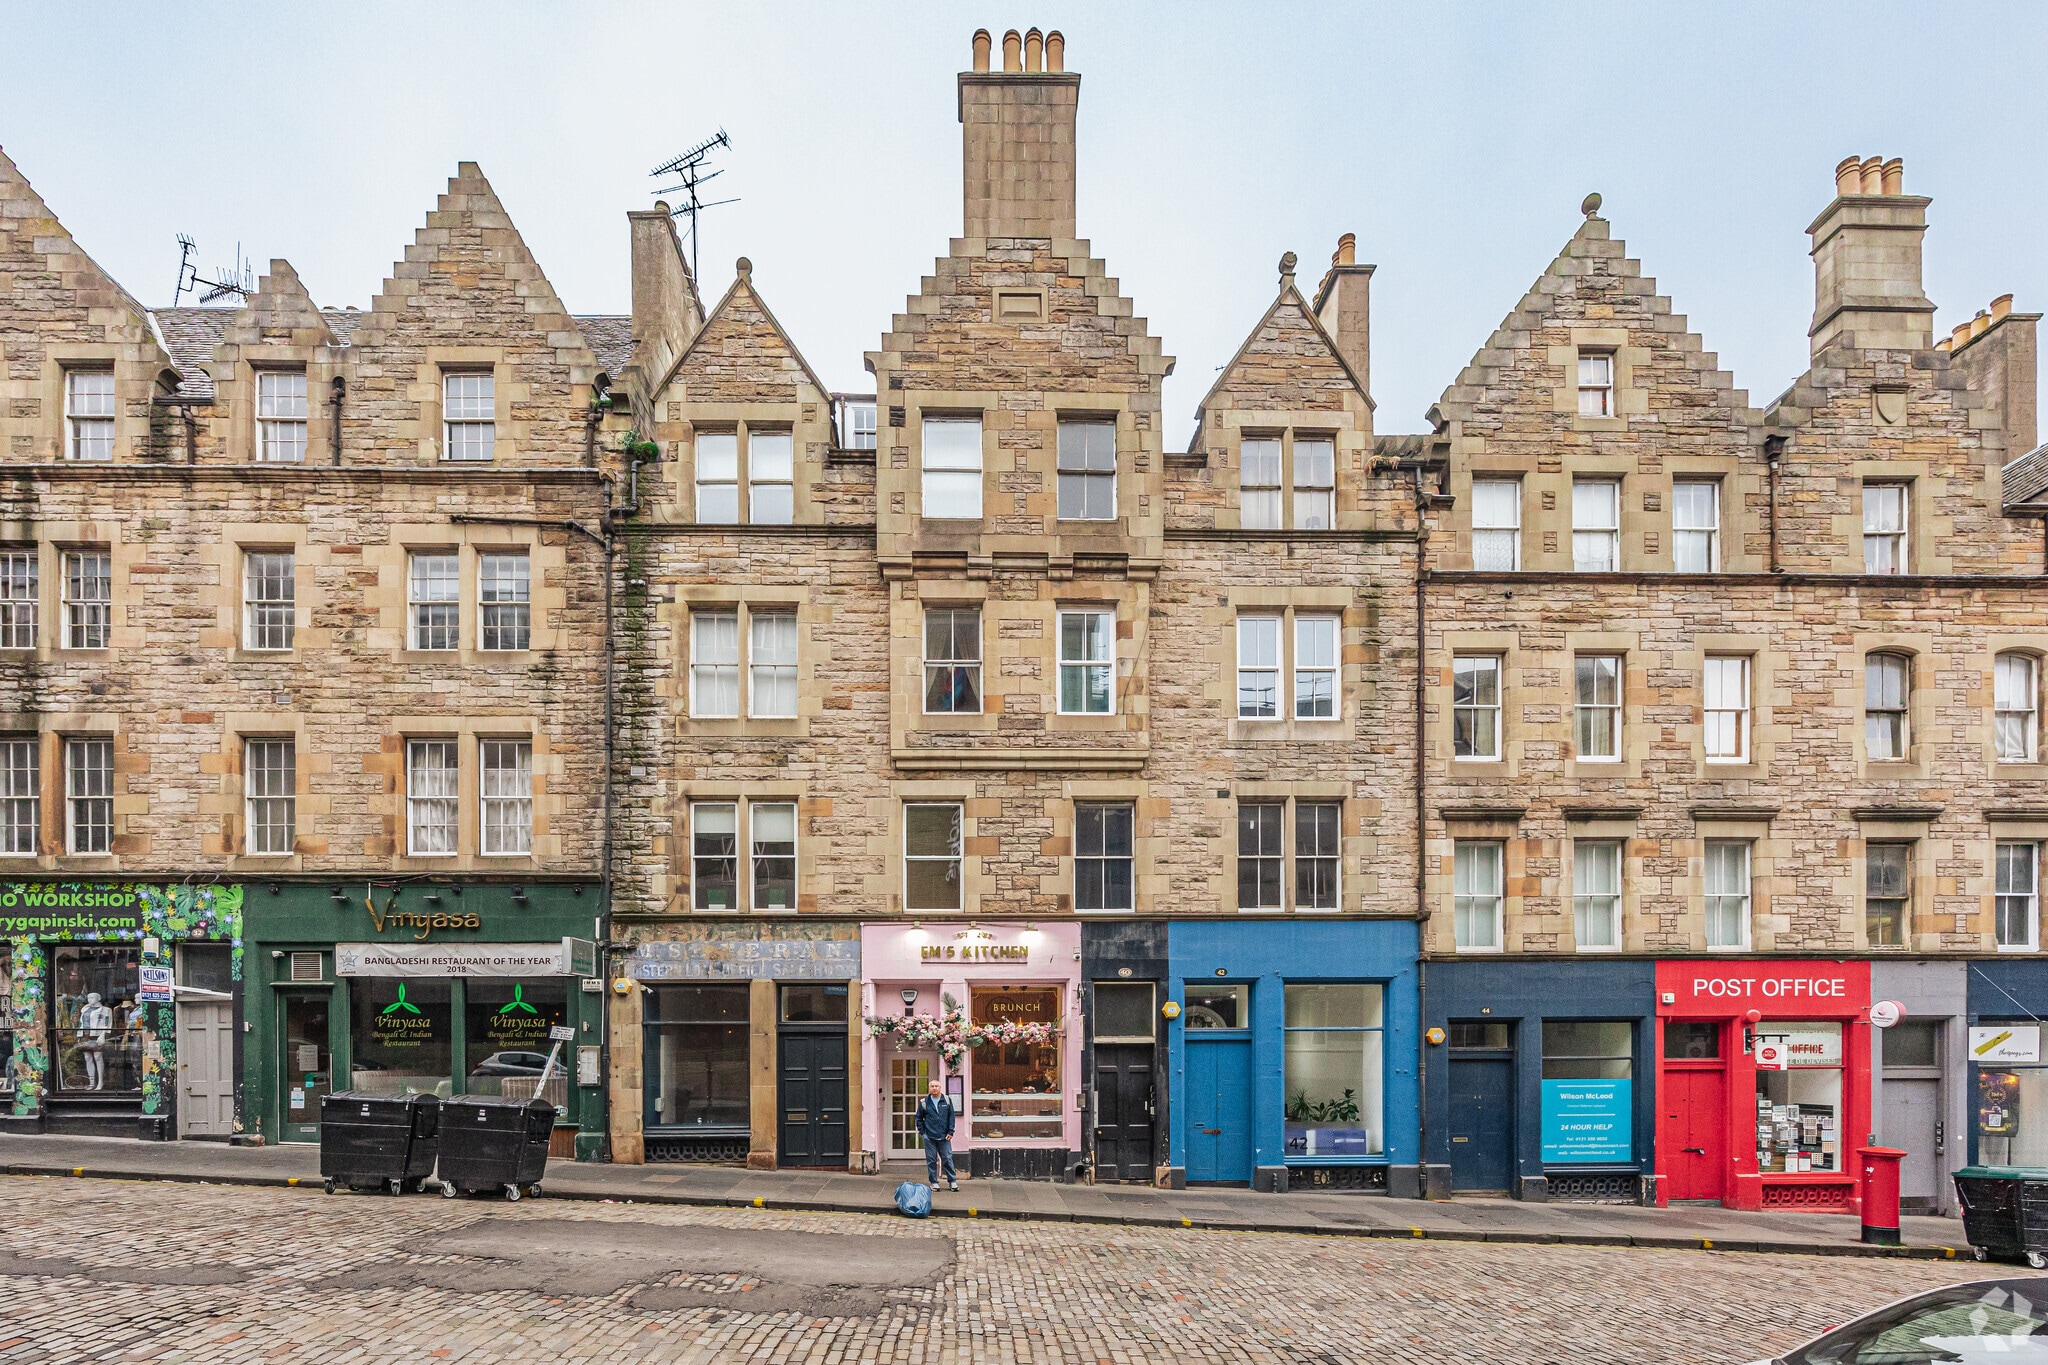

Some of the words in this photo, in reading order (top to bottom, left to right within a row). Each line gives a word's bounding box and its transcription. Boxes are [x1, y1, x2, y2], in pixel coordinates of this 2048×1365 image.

[23, 893, 136, 907] WORKSHOP
[365, 898, 480, 940] Vinyasa
[920, 945, 956, 959] EM'S
[962, 945, 1029, 959] KITCHEN
[364, 957, 430, 965] BANGLADESHI
[432, 957, 492, 965] RESTAURANT
[494, 957, 506, 965] OF
[508, 957, 525, 965] THE
[527, 957, 551, 965] YEAR
[1693, 978, 1756, 997] POST
[1761, 978, 1845, 997] OFFICE
[993, 1003, 1040, 1012] BRUNCH
[374, 1014, 431, 1032] Vinyasa
[490, 1014, 546, 1032] Vinyasa
[371, 1031, 398, 1039] Bengali
[487, 1031, 514, 1039] Bengali
[1791, 1044, 1824, 1054] OFFICE
[1289, 1137, 1309, 1150] 42
